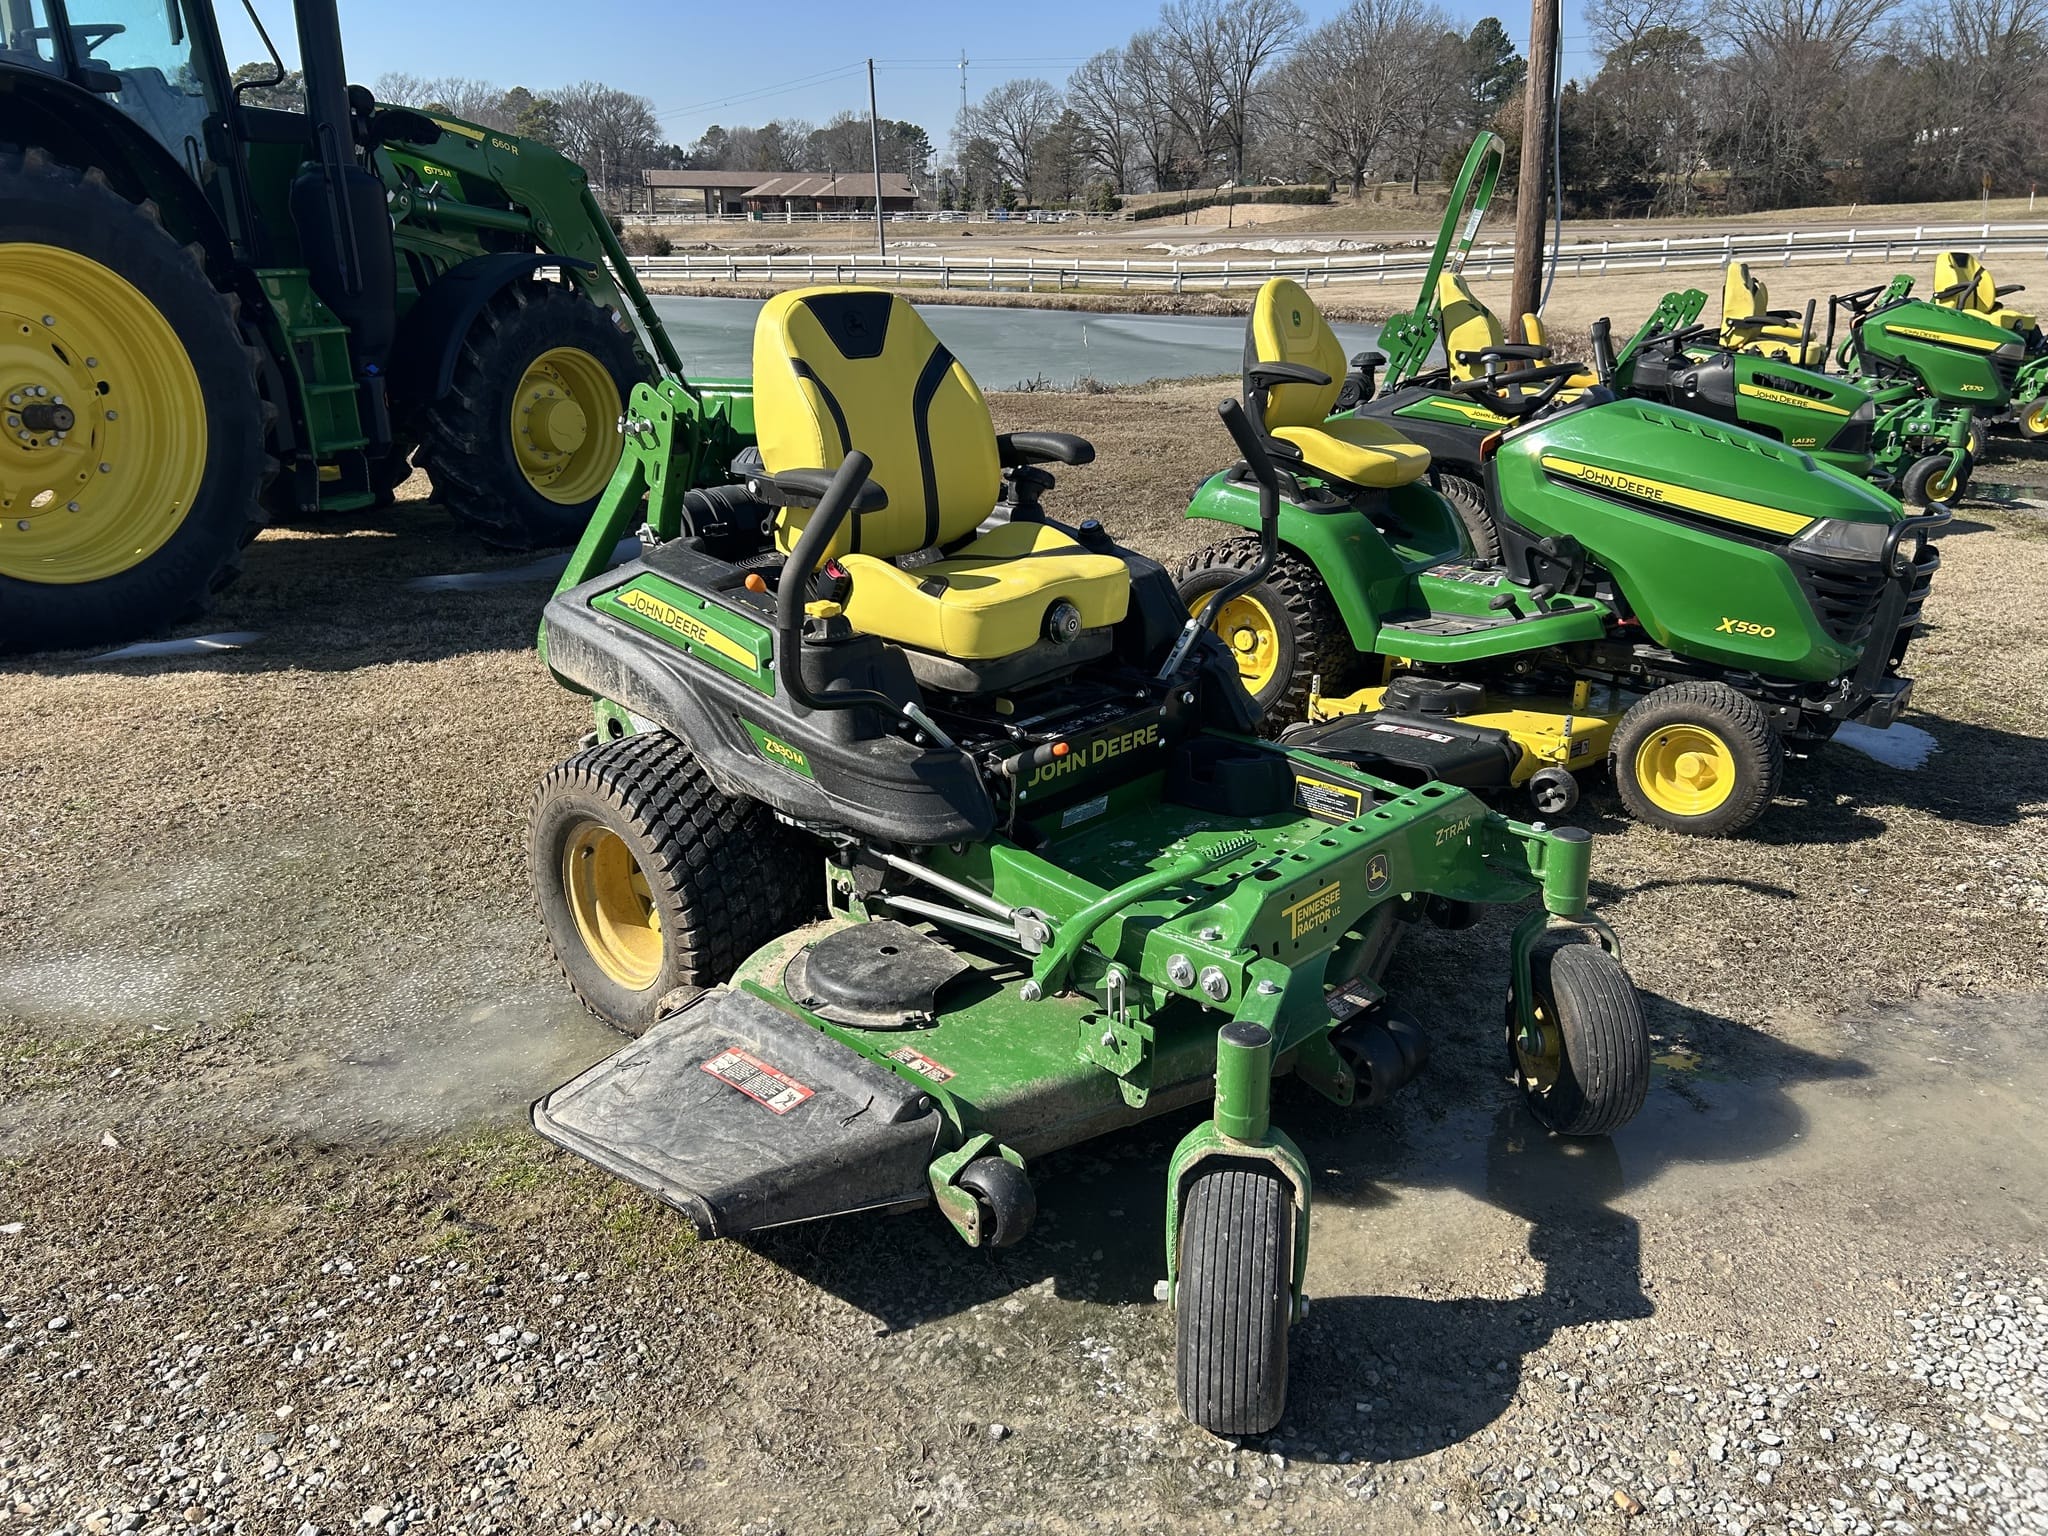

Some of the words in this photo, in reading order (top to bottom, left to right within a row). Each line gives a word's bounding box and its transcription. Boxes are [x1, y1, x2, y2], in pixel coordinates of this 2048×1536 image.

[1754, 389, 1778, 401] JOHN
[1779, 394, 1809, 407] DEERE
[1471, 410, 1491, 419] JOHN
[1577, 466, 1615, 486] JOHN
[1616, 476, 1664, 500] DEERE
[629, 593, 663, 620] JOHN
[665, 608, 708, 642] DEERE
[1715, 617, 1776, 638] X590
[763, 736, 804, 766] Z930M
[1028, 749, 1087, 787] JOHN
[1092, 723, 1159, 764] DEERE
[1281, 880, 1340, 940] TENNESSEE
[1332, 906, 1340, 917] LLC
